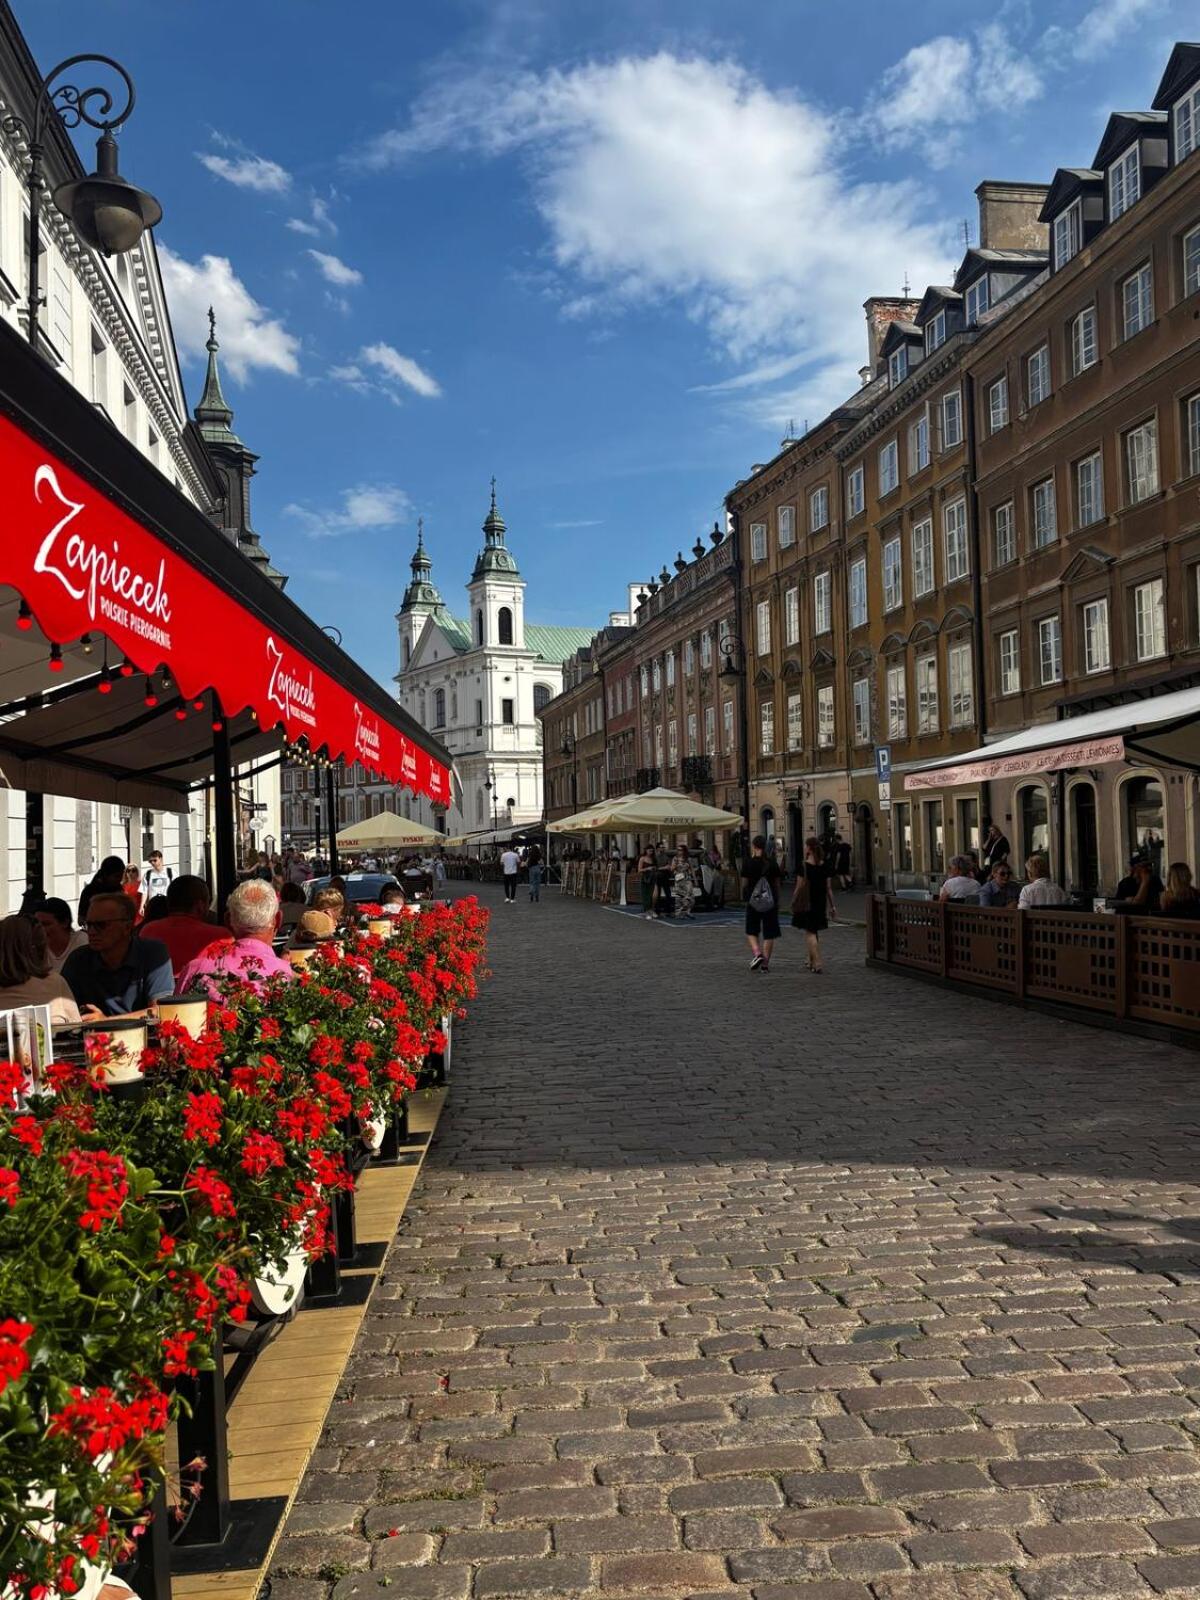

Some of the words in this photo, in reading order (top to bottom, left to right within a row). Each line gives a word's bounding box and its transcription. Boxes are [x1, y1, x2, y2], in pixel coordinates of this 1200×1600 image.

[34, 464, 171, 622] Zapiecek
[100, 595, 129, 628] POLSKIE
[130, 612, 172, 651] PIEROGARNIE
[266, 636, 316, 720] Zapiecek
[878, 749, 888, 772] P
